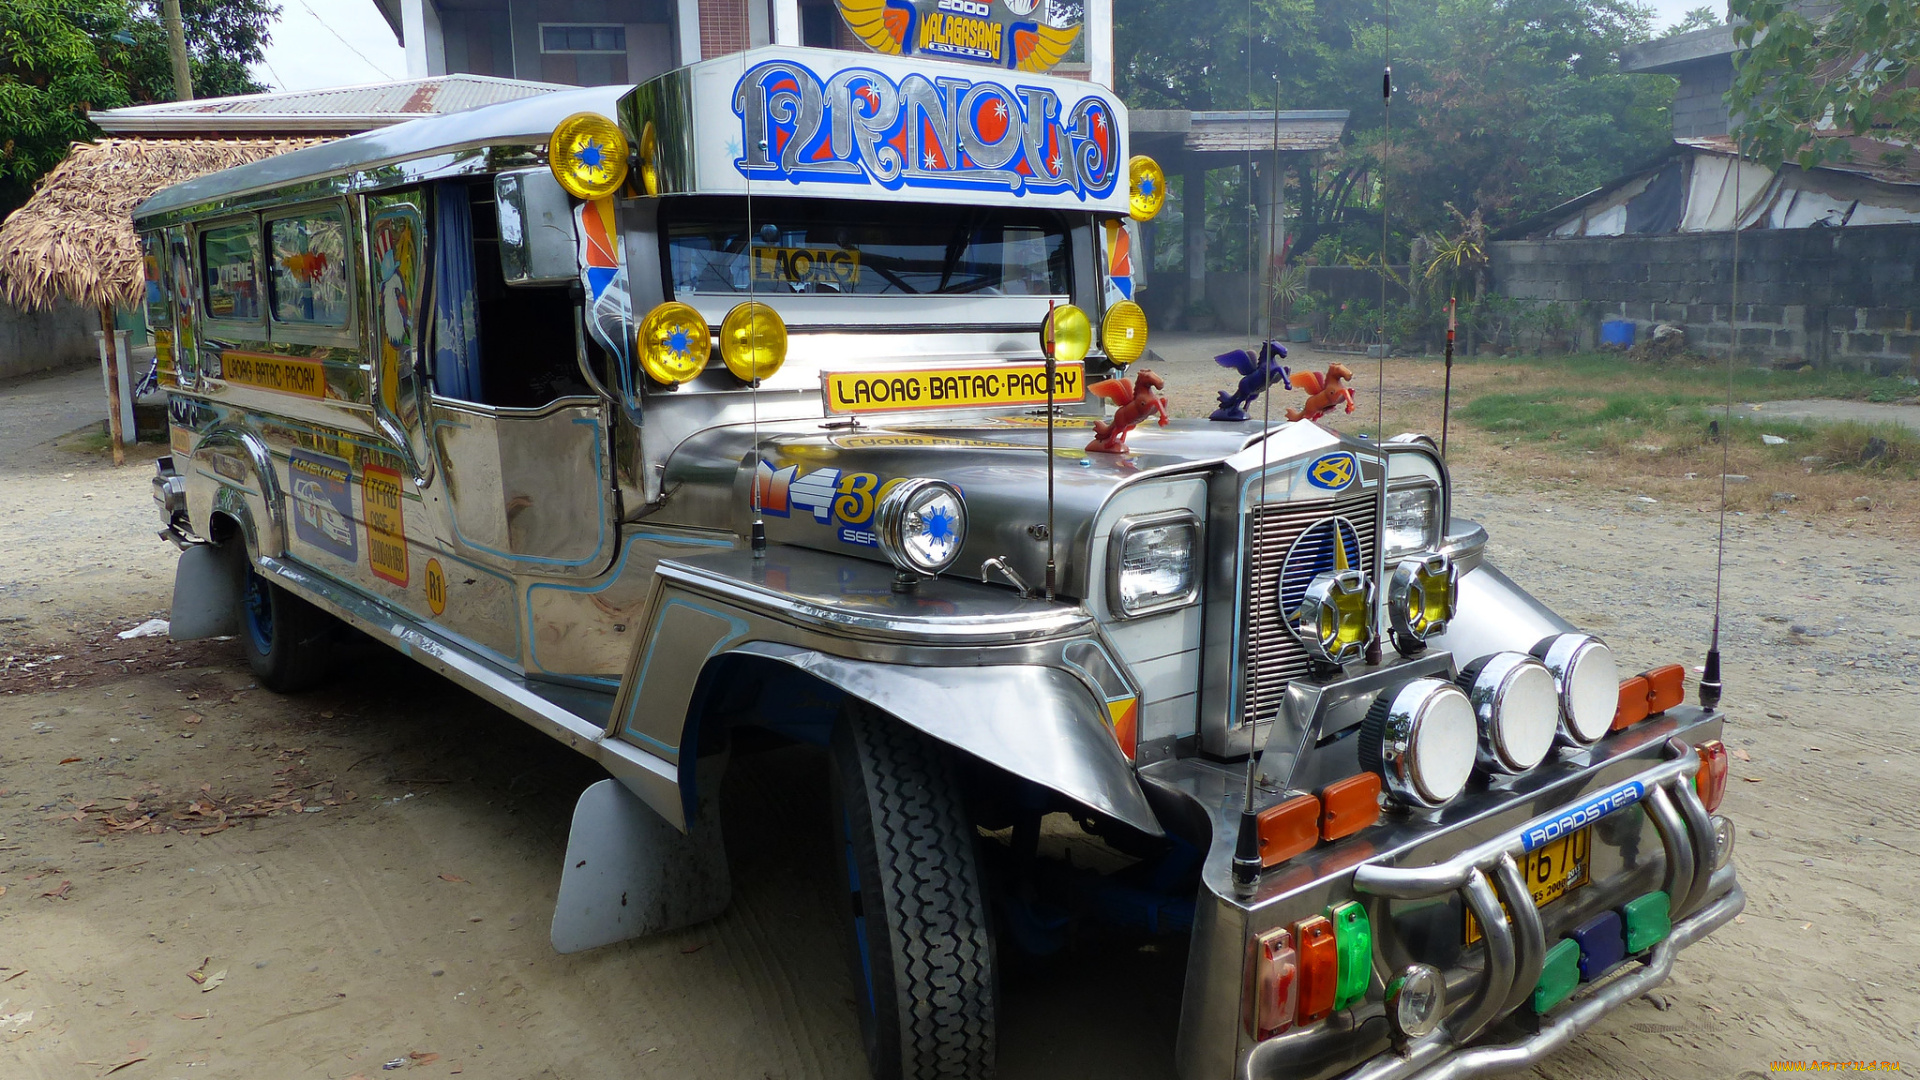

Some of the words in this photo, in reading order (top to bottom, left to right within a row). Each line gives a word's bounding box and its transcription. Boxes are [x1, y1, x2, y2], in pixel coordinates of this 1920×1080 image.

[938, 0, 989, 17] 2000
[920, 12, 1002, 60] MALAGASANG
[755, 249, 855, 282] LAOAG
[837, 377, 921, 404] LAOAG
[930, 375, 1000, 400] BATAC
[365, 476, 398, 510] LTFRB
[1530, 786, 1638, 847] ROADSTER
